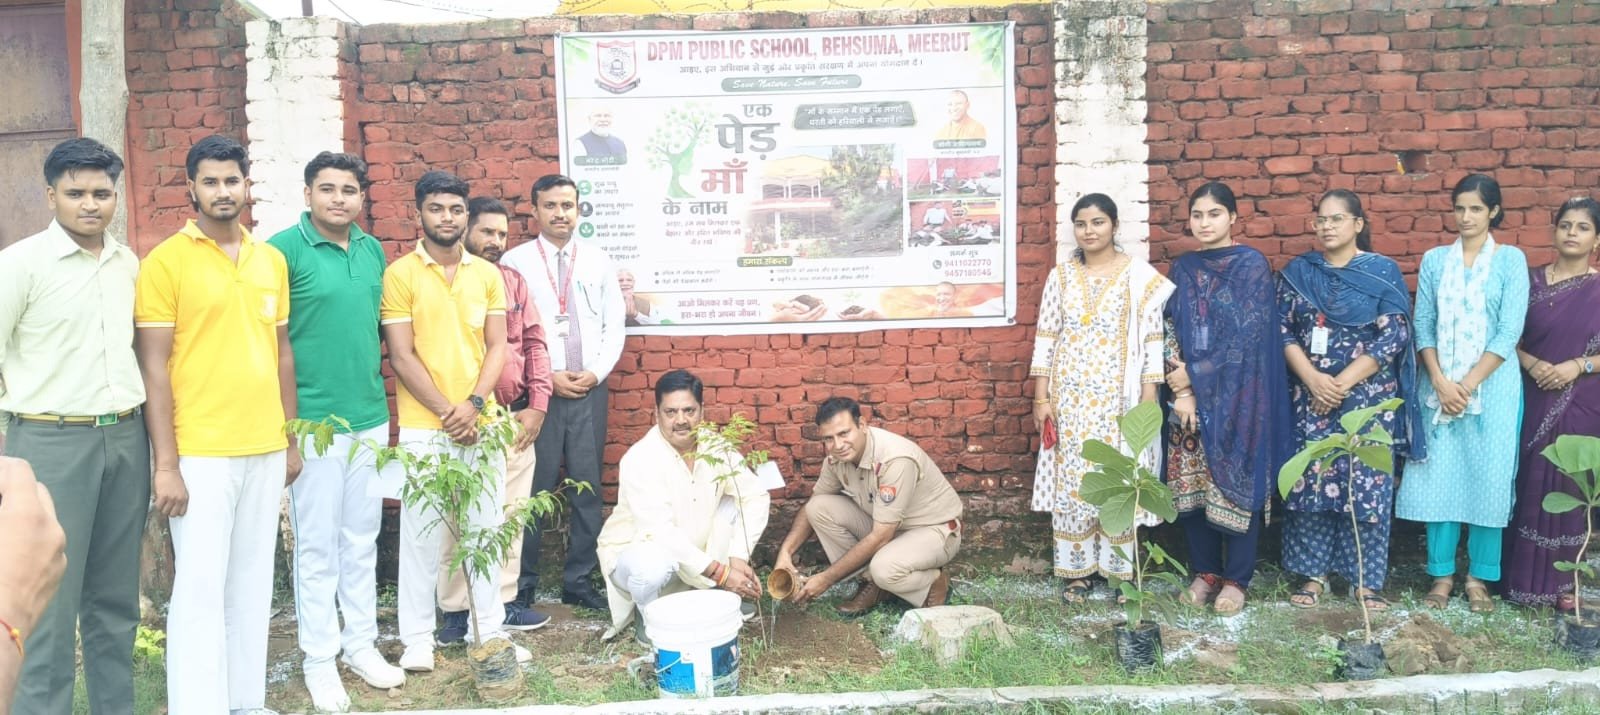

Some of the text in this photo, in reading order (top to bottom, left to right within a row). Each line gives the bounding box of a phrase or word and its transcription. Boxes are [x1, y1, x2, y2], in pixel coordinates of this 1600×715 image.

[647, 41, 683, 61] DPM
[688, 39, 745, 60] PUBLIC
[750, 37, 817, 60] SCHOOL,
[822, 34, 903, 57] BEHSUMA,
[908, 32, 970, 53] MEERUT
[733, 79, 754, 89] Save
[794, 77, 816, 87] Save
[819, 76, 849, 86] Future
[743, 103, 773, 118] एक
[714, 113, 780, 160] पेड़
[701, 158, 748, 194] माँ
[662, 198, 728, 215] के नाम
